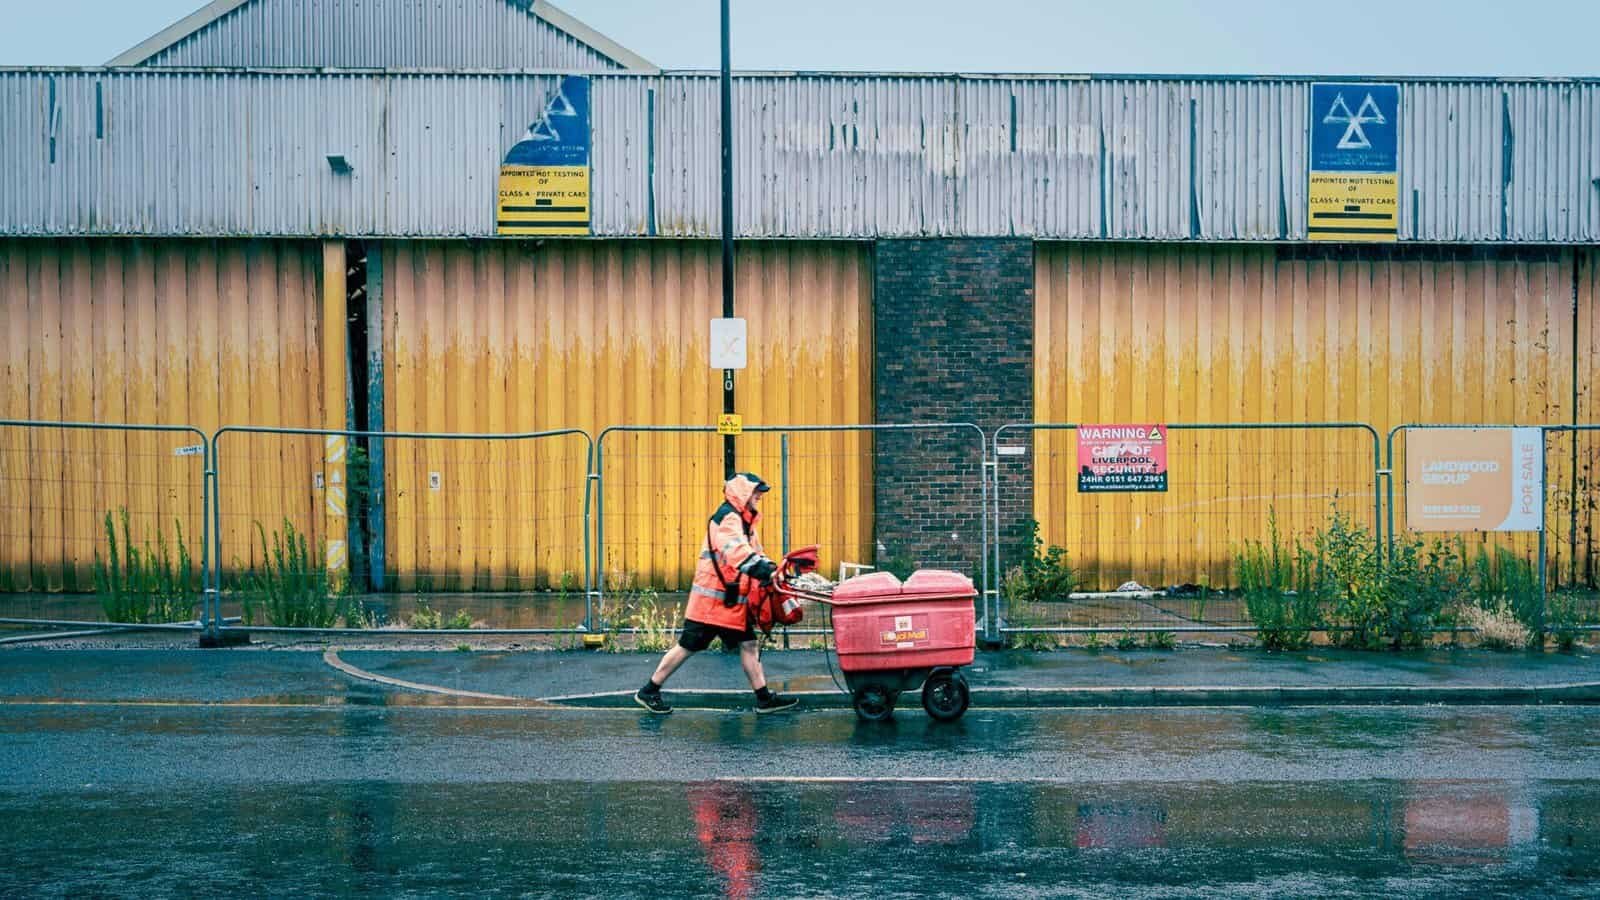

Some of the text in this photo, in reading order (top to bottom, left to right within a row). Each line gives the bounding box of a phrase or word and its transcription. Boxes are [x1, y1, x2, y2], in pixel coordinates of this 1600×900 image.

[1080, 427, 1146, 439] WARNING
[1092, 445, 1127, 456] CY
[1092, 456, 1152, 464] LIVERPOOL
[1092, 465, 1152, 474] SECURITY
[1422, 461, 1500, 473] LANDWOOD
[1081, 475, 1103, 483] 24HR
[1521, 443, 1534, 514] FOR SALE
[908, 630, 926, 640] Mail
